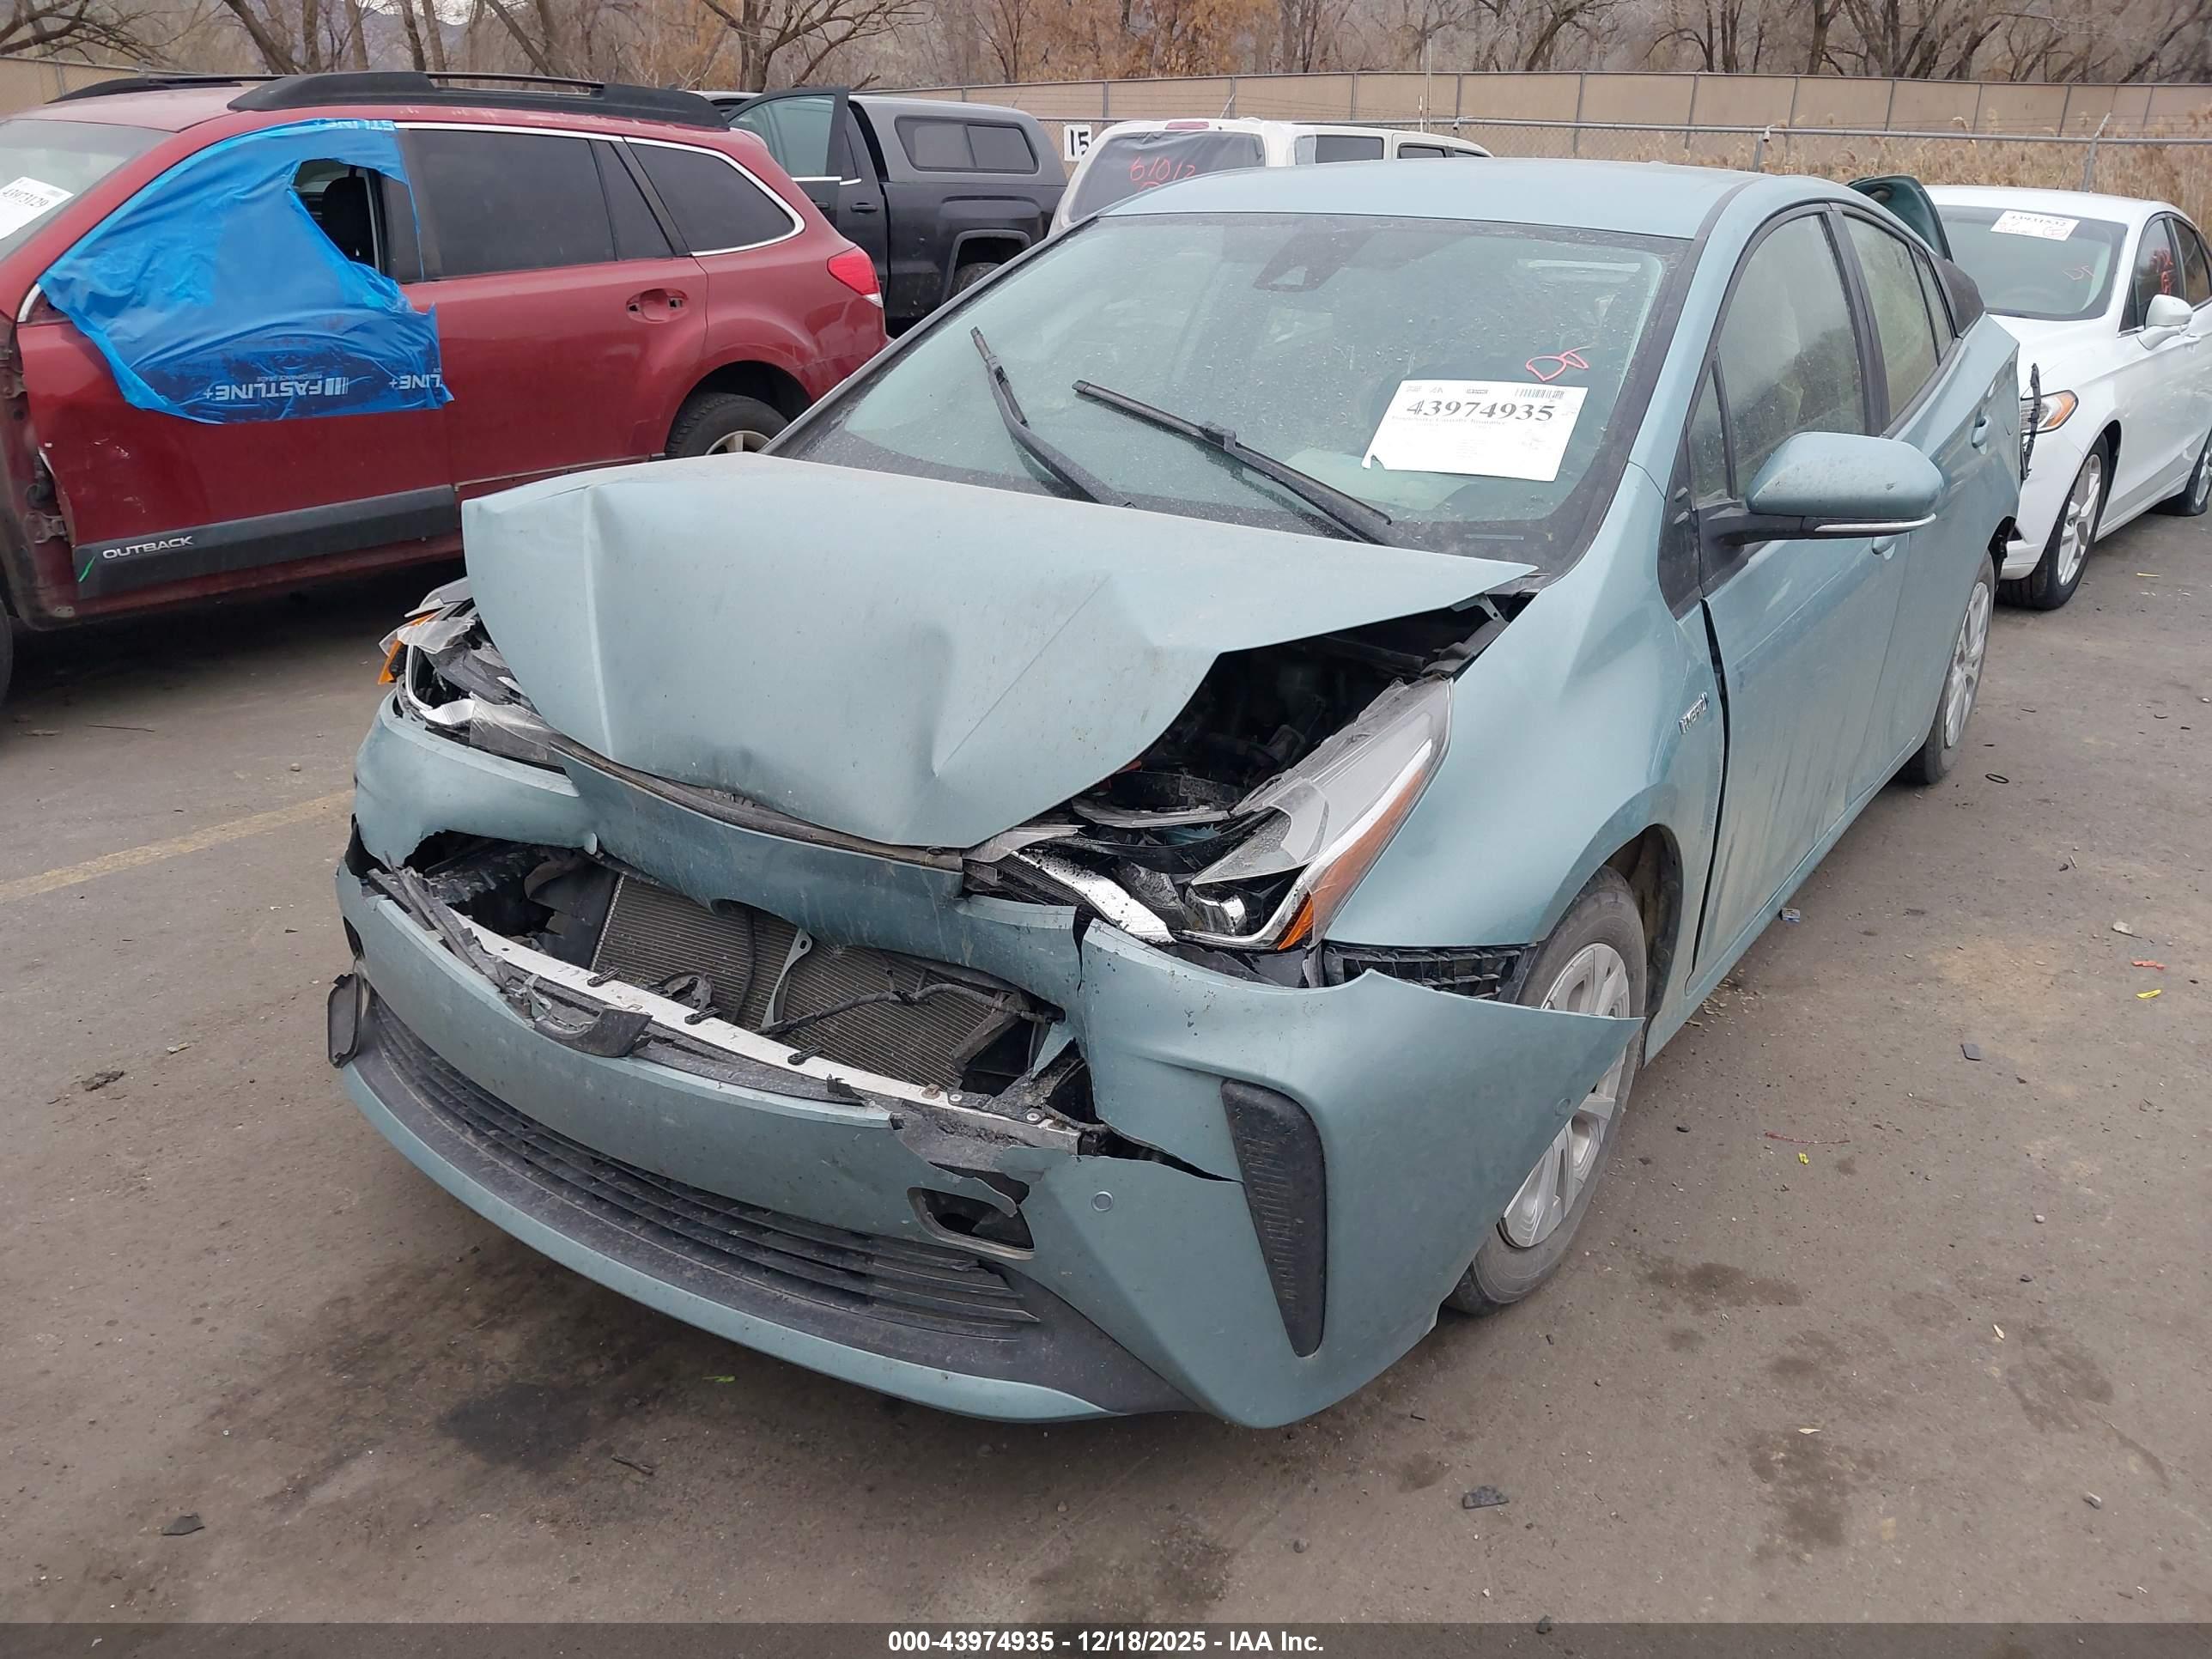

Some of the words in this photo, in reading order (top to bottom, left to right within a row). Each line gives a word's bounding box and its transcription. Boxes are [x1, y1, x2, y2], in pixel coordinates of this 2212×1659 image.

[1070, 129, 1089, 156] 15
[204, 380, 323, 401] FASTLINE+
[1406, 399, 1556, 422] 43974935
[102, 535, 194, 560] OUTBACK
